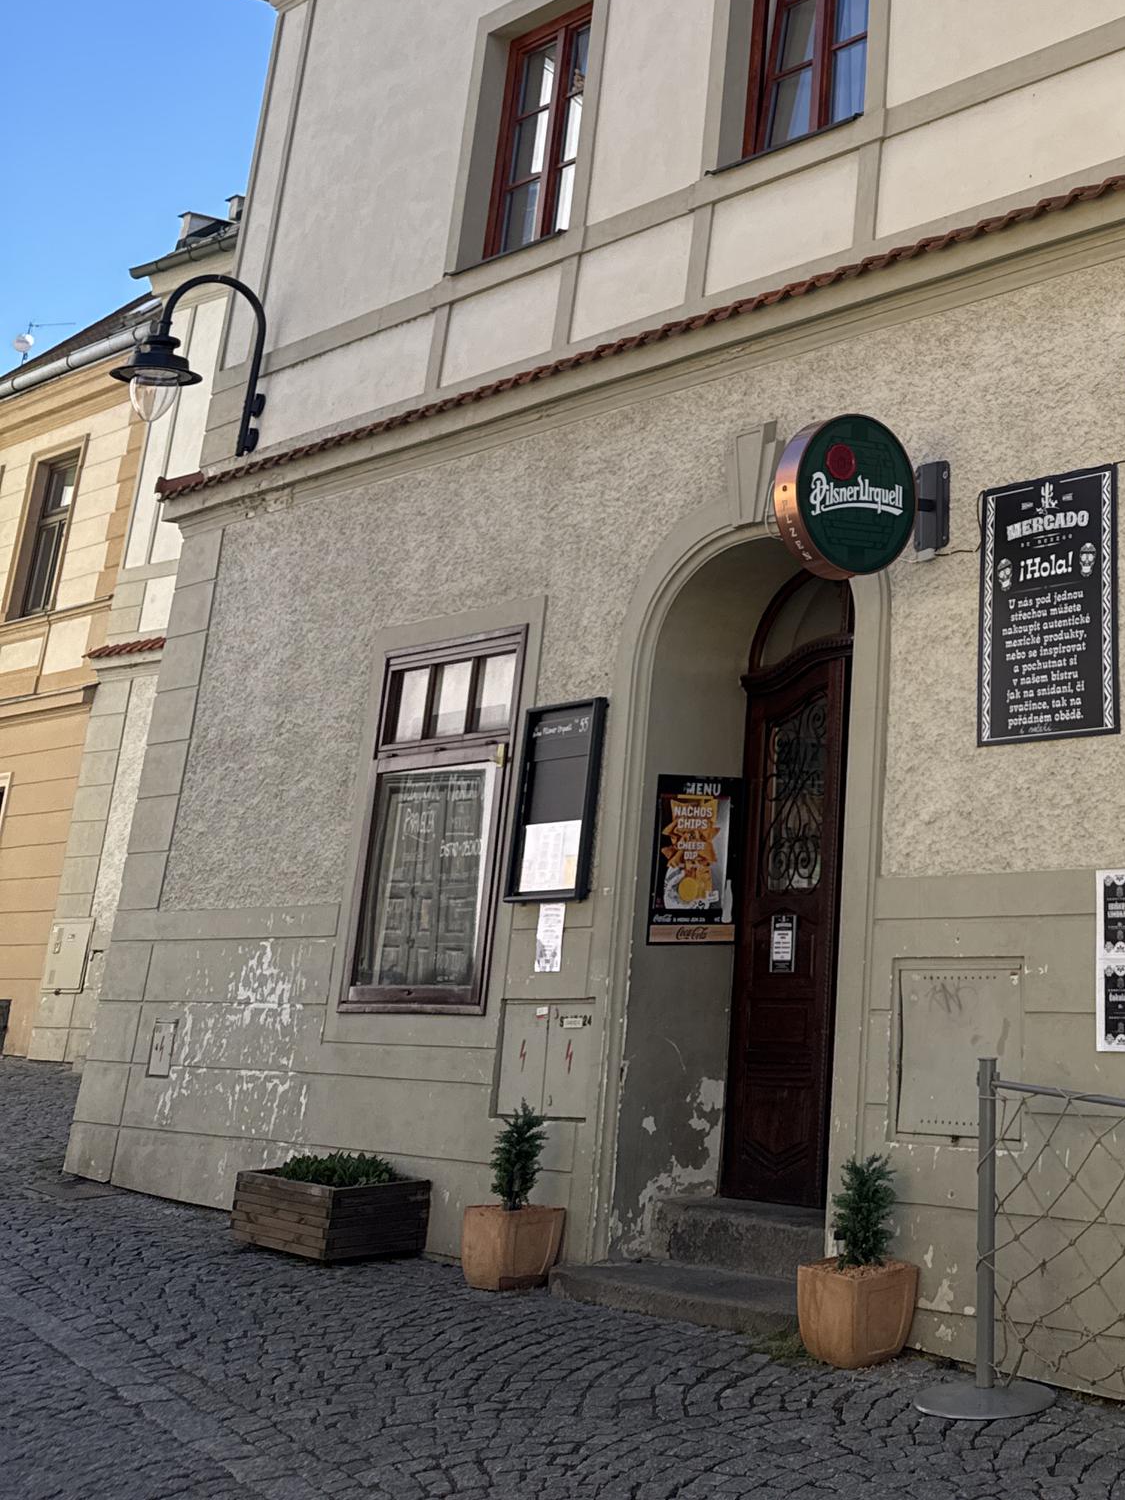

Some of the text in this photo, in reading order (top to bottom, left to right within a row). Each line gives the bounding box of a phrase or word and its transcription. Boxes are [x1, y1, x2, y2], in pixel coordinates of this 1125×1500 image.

[809, 471, 903, 516] Pilsner Urquell
[1006, 510, 1089, 541] MERCADO
[1019, 551, 1073, 582] ¡Hola!
[1008, 590, 1083, 609] U nás pod jednou
[1010, 608, 1047, 622] střechou
[1002, 613, 1090, 636] nakoupit autentické
[1005, 629, 1087, 648] mexické produkty,
[1005, 642, 1086, 661] nebo se inspirovat
[1013, 654, 1077, 675] a pochutnat si
[1012, 670, 1078, 686] v našem bistru
[1006, 689, 1021, 703] jak
[1023, 689, 1034, 698] na
[1009, 696, 1082, 713] svačince, tak na
[1008, 708, 1083, 729] pořádném obědě.
[685, 782, 722, 796] MENU
[673, 806, 713, 818] NACHOS
[677, 818, 708, 830] CHIPS
[677, 841, 705, 850] CHEESE
[684, 851, 698, 860] DIP
